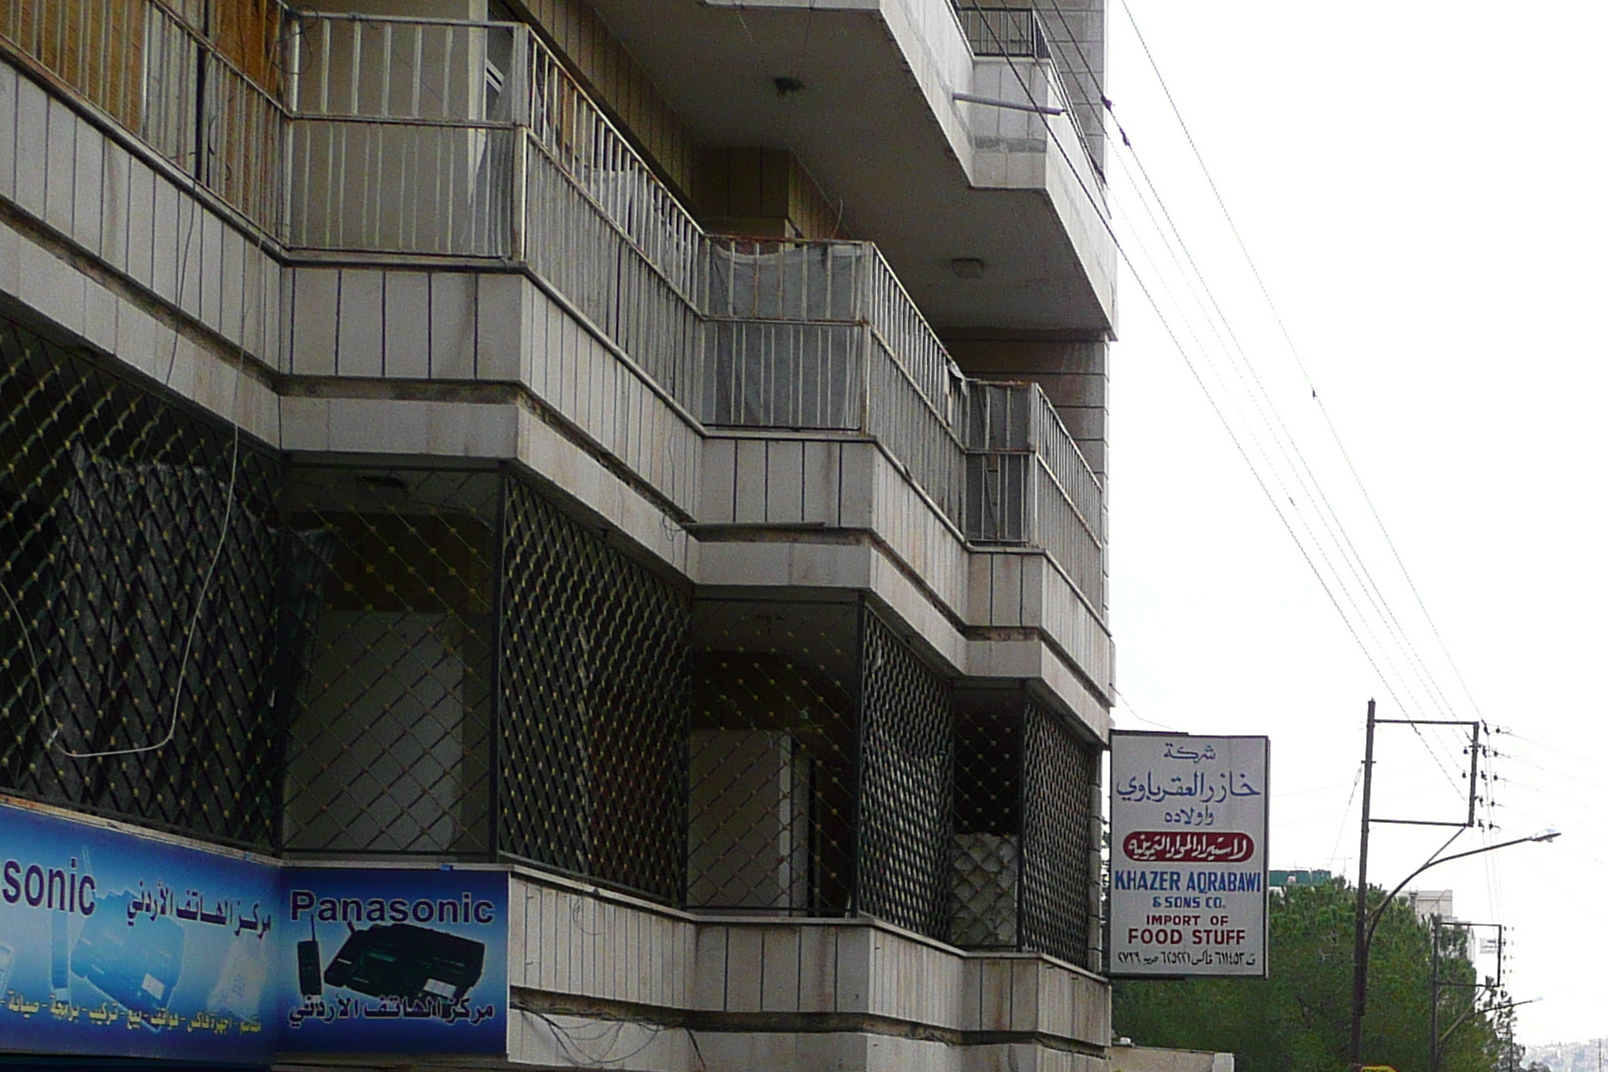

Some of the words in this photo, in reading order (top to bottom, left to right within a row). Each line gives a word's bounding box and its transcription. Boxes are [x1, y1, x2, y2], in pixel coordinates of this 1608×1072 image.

[1164, 742, 1216, 764] شركة
[1116, 770, 1205, 803] العقرباوي
[1199, 770, 1261, 803] خازر
[1115, 870, 1181, 891] KHAZER
[1186, 871, 1262, 894] AQRABAWI
[127, 880, 175, 926] الأردني
[176, 890, 233, 927] الهاتف
[290, 890, 495, 924] Panasonic
[1152, 896, 1162, 909] &
[1164, 896, 1200, 909] SONS
[236, 902, 272, 940] مركز
[1128, 928, 1183, 945] FOOD
[1192, 929, 1246, 945] STUFF
[1146, 915, 1201, 926] IMPORT
[1210, 915, 1228, 926] OF
[288, 991, 359, 1030] الأردني
[363, 996, 443, 1019] الهاتف
[443, 995, 495, 1026] مركز
